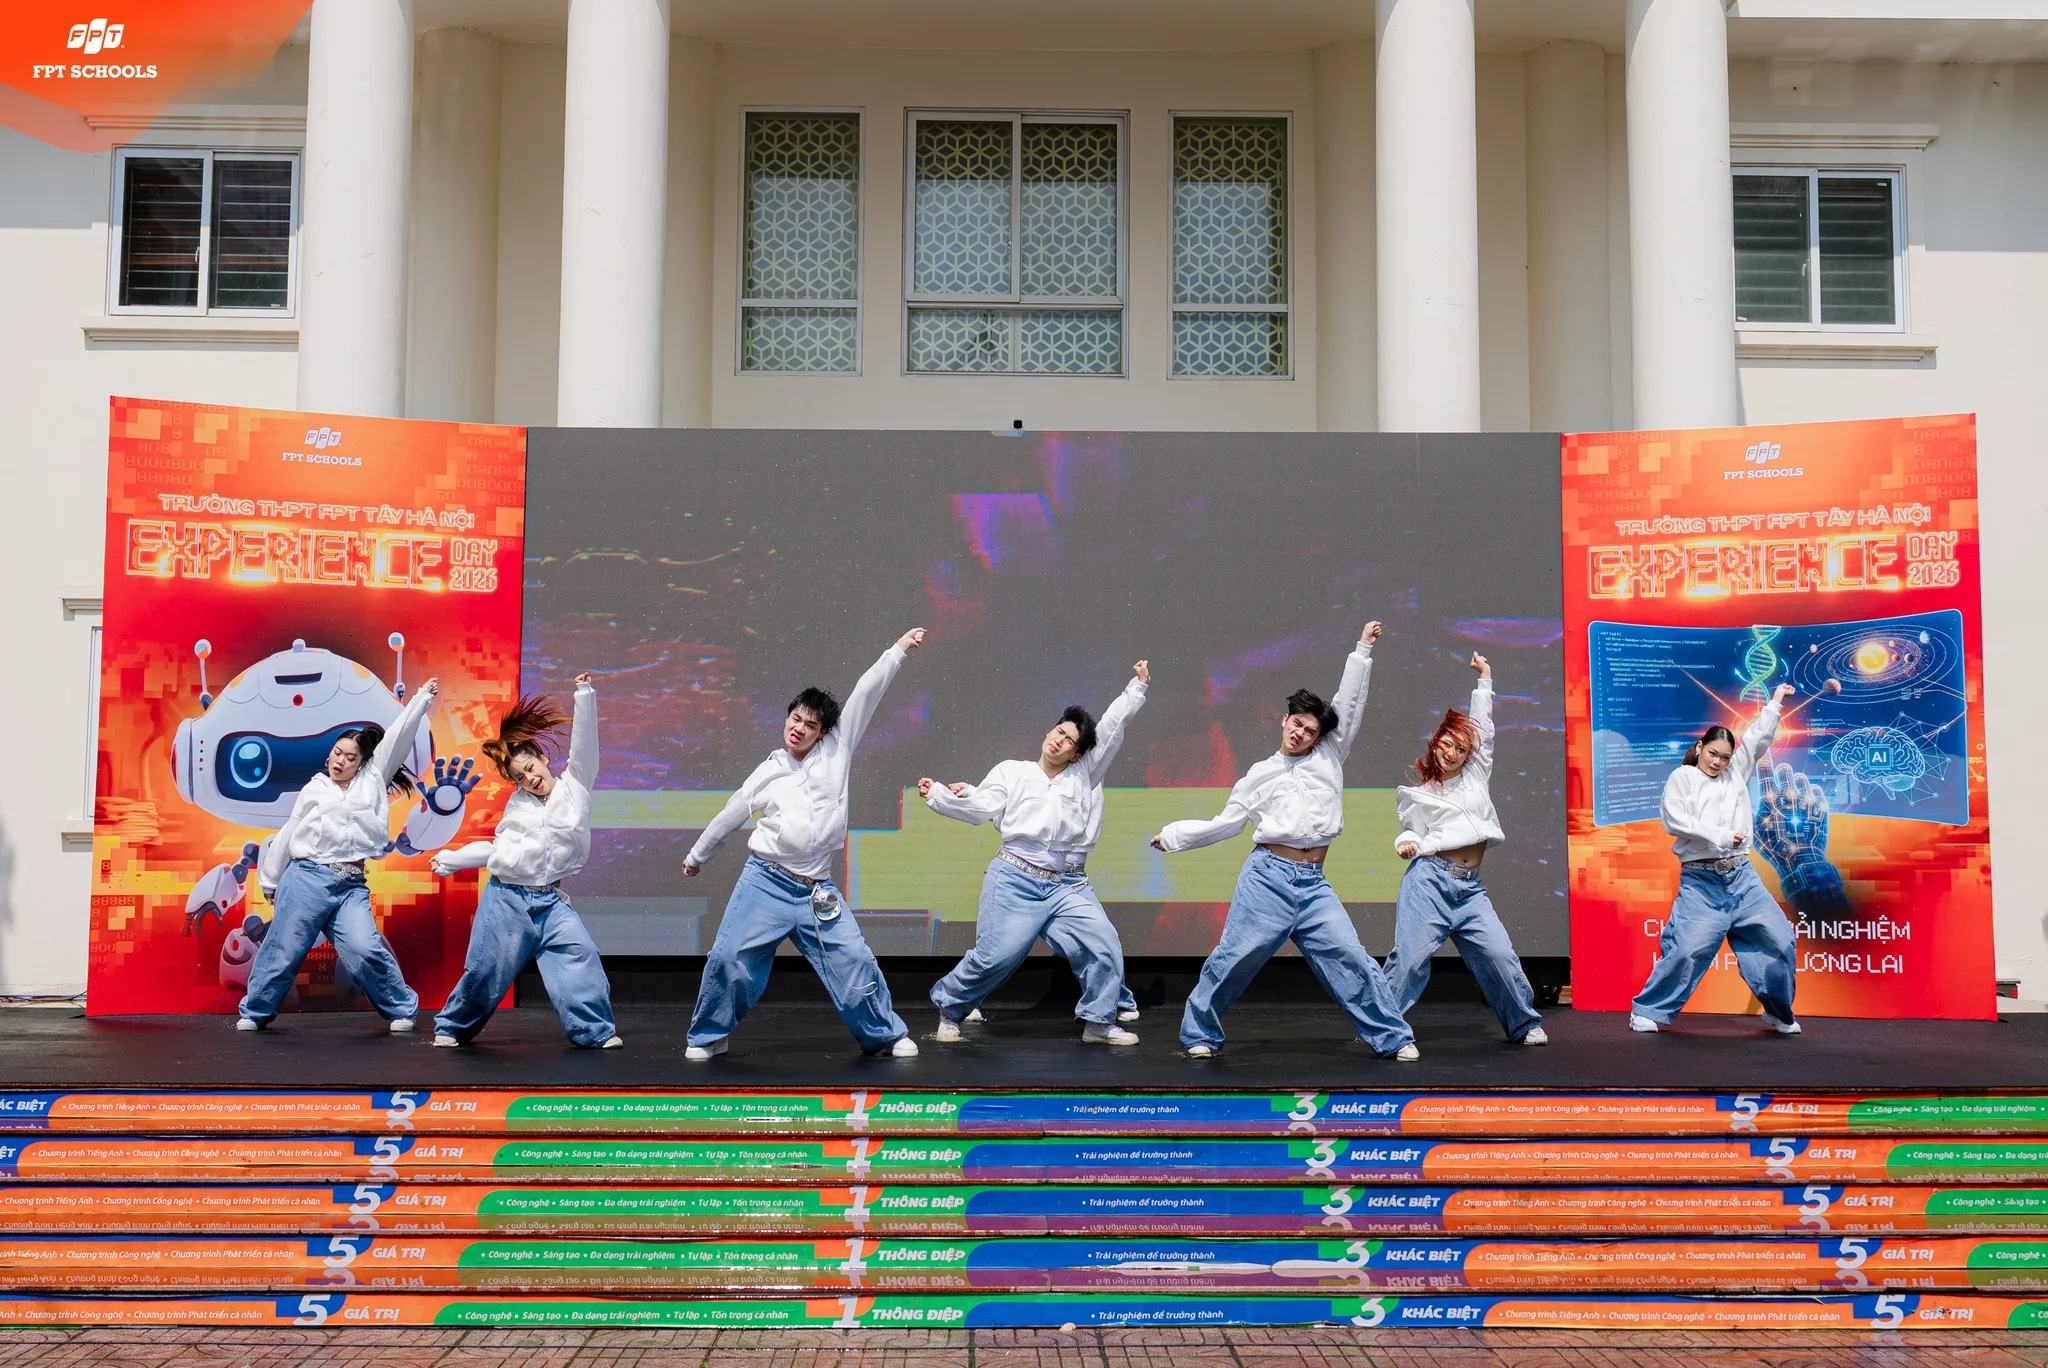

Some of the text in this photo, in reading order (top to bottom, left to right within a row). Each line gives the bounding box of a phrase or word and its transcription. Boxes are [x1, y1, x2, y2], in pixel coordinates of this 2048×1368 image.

[304, 427, 341, 448] FPT
[282, 452, 362, 466] FPT SCHOOLS
[1745, 441, 1781, 464] FPT
[1724, 467, 1803, 480] FPT SCHOOLS
[158, 493, 475, 531] TRƯỜNG THPT FPT TÂY HÀ NỘI
[1615, 503, 1931, 536] TRƯỜNG THPT FPT TÂY HÀ NỘI
[127, 519, 442, 591] EXPERIENCE
[450, 537, 498, 567] DAY
[1906, 531, 1958, 561] DAY
[450, 566, 497, 592] 2026
[1588, 534, 1898, 599] EXPERIENCE
[1907, 560, 1960, 588] 2026
[1871, 751, 1887, 763] AI
[1821, 914, 1911, 944] NGHIỆM
[1867, 954, 1904, 973] LAI
[16, 1098, 47, 1113] BIỆT
[386, 1091, 478, 1119] 5 GIÁ TRỊ
[845, 1091, 957, 1119] 1 THÔNG ĐIỆP
[1117, 1105, 1130, 1113] để
[1129, 1106, 1156, 1115] trưởng
[1157, 1105, 1180, 1113] thành
[1288, 1092, 1399, 1120] 3 KHÁC BIỆT
[1730, 1092, 1761, 1120] 5
[1771, 1102, 1795, 1114] GIÁ
[369, 1136, 464, 1165] 5 GIÁ TRỊ
[846, 1137, 962, 1166] 1 THÔNG ĐIỆP
[1082, 1150, 1193, 1161] Trải nghiệm để trưởng thành
[1305, 1138, 1421, 1168] 3 KHÁC BIỆT
[1765, 1137, 1857, 1166] 5 GIÁ TRỊ
[4, 1197, 35, 1207] Chương
[35, 1196, 55, 1205] trình
[55, 1196, 77, 1206] Tiếng
[77, 1197, 94, 1205] Anh
[102, 1197, 132, 1206] Chương
[133, 1197, 152, 1205] trình
[152, 1197, 173, 1207] Công
[173, 1197, 194, 1207] nghệ
[202, 1197, 232, 1207] Chương
[232, 1197, 252, 1205] trình
[251, 1197, 271, 1205] Phát
[271, 1196, 290, 1205] triển
[348, 1183, 447, 1213] 5 GIÁ TRỊ
[844, 1185, 965, 1215] 1 THÔNG ĐIỆP
[1089, 1198, 1205, 1208] Trải nghiệm để trưởng thành
[1321, 1185, 1441, 1215] 3 KHÁC BIỆT
[1799, 1184, 1895, 1215] 5 GIÁ TRỊ
[323, 1235, 426, 1267] 5 GIÁ TRỊ
[840, 1237, 966, 1269] 1 THÔNG ĐIỆP
[1095, 1251, 1215, 1261] Trải nghiệm để trưởng thành
[1339, 1238, 1462, 1268] 3 KHÁC BIỆT
[1835, 1237, 1935, 1269] 5 GIÁ TRỊ
[293, 1294, 400, 1325] 5 GIÁ TRỊ
[464, 1310, 789, 1322] Công nghệ Sáng tạo Đa dạng trải nghiệm Tự lập Tôn trọng cá nhân
[832, 1295, 964, 1327] 1 THÔNG ĐIỆP
[1099, 1310, 1224, 1322] Trải nghiệm để trưởng thành
[1351, 1296, 1481, 1326] 3 KHÁC BIỆT
[1870, 1294, 1905, 1328] 5
[1949, 1308, 1974, 1321] TRỊ
